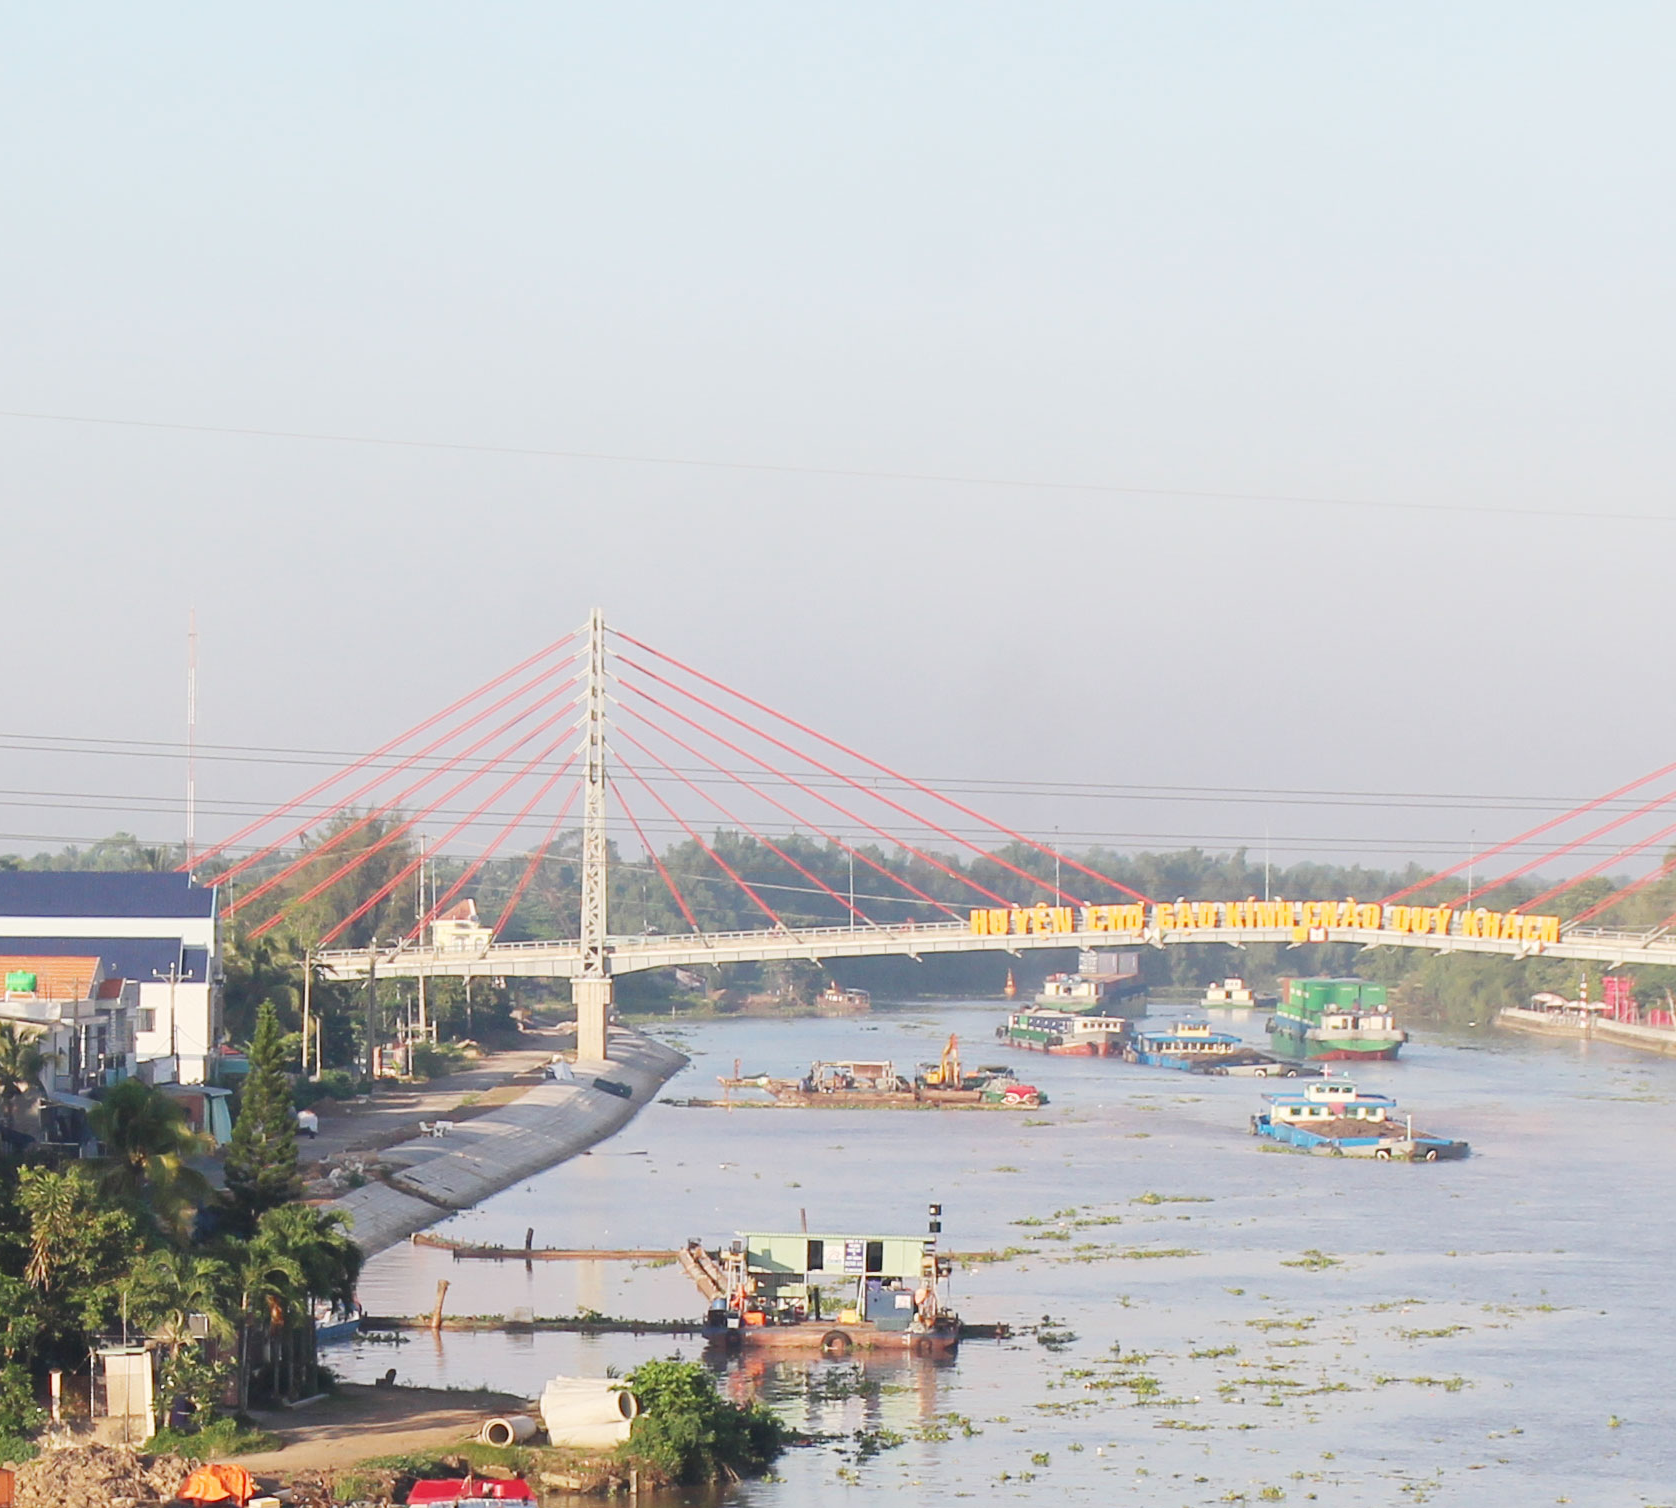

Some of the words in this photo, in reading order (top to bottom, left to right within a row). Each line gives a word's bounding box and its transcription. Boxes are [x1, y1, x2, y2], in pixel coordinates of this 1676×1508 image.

[970, 901, 1073, 940] HUYỆN
[1087, 900, 1145, 937] CHỢ
[1156, 902, 1218, 935] GẠO
[1225, 896, 1295, 928] KÍNH
[1302, 897, 1383, 929] CHÀO
[1392, 903, 1453, 935] QUÝ
[1462, 908, 1560, 943] KHÁCH
